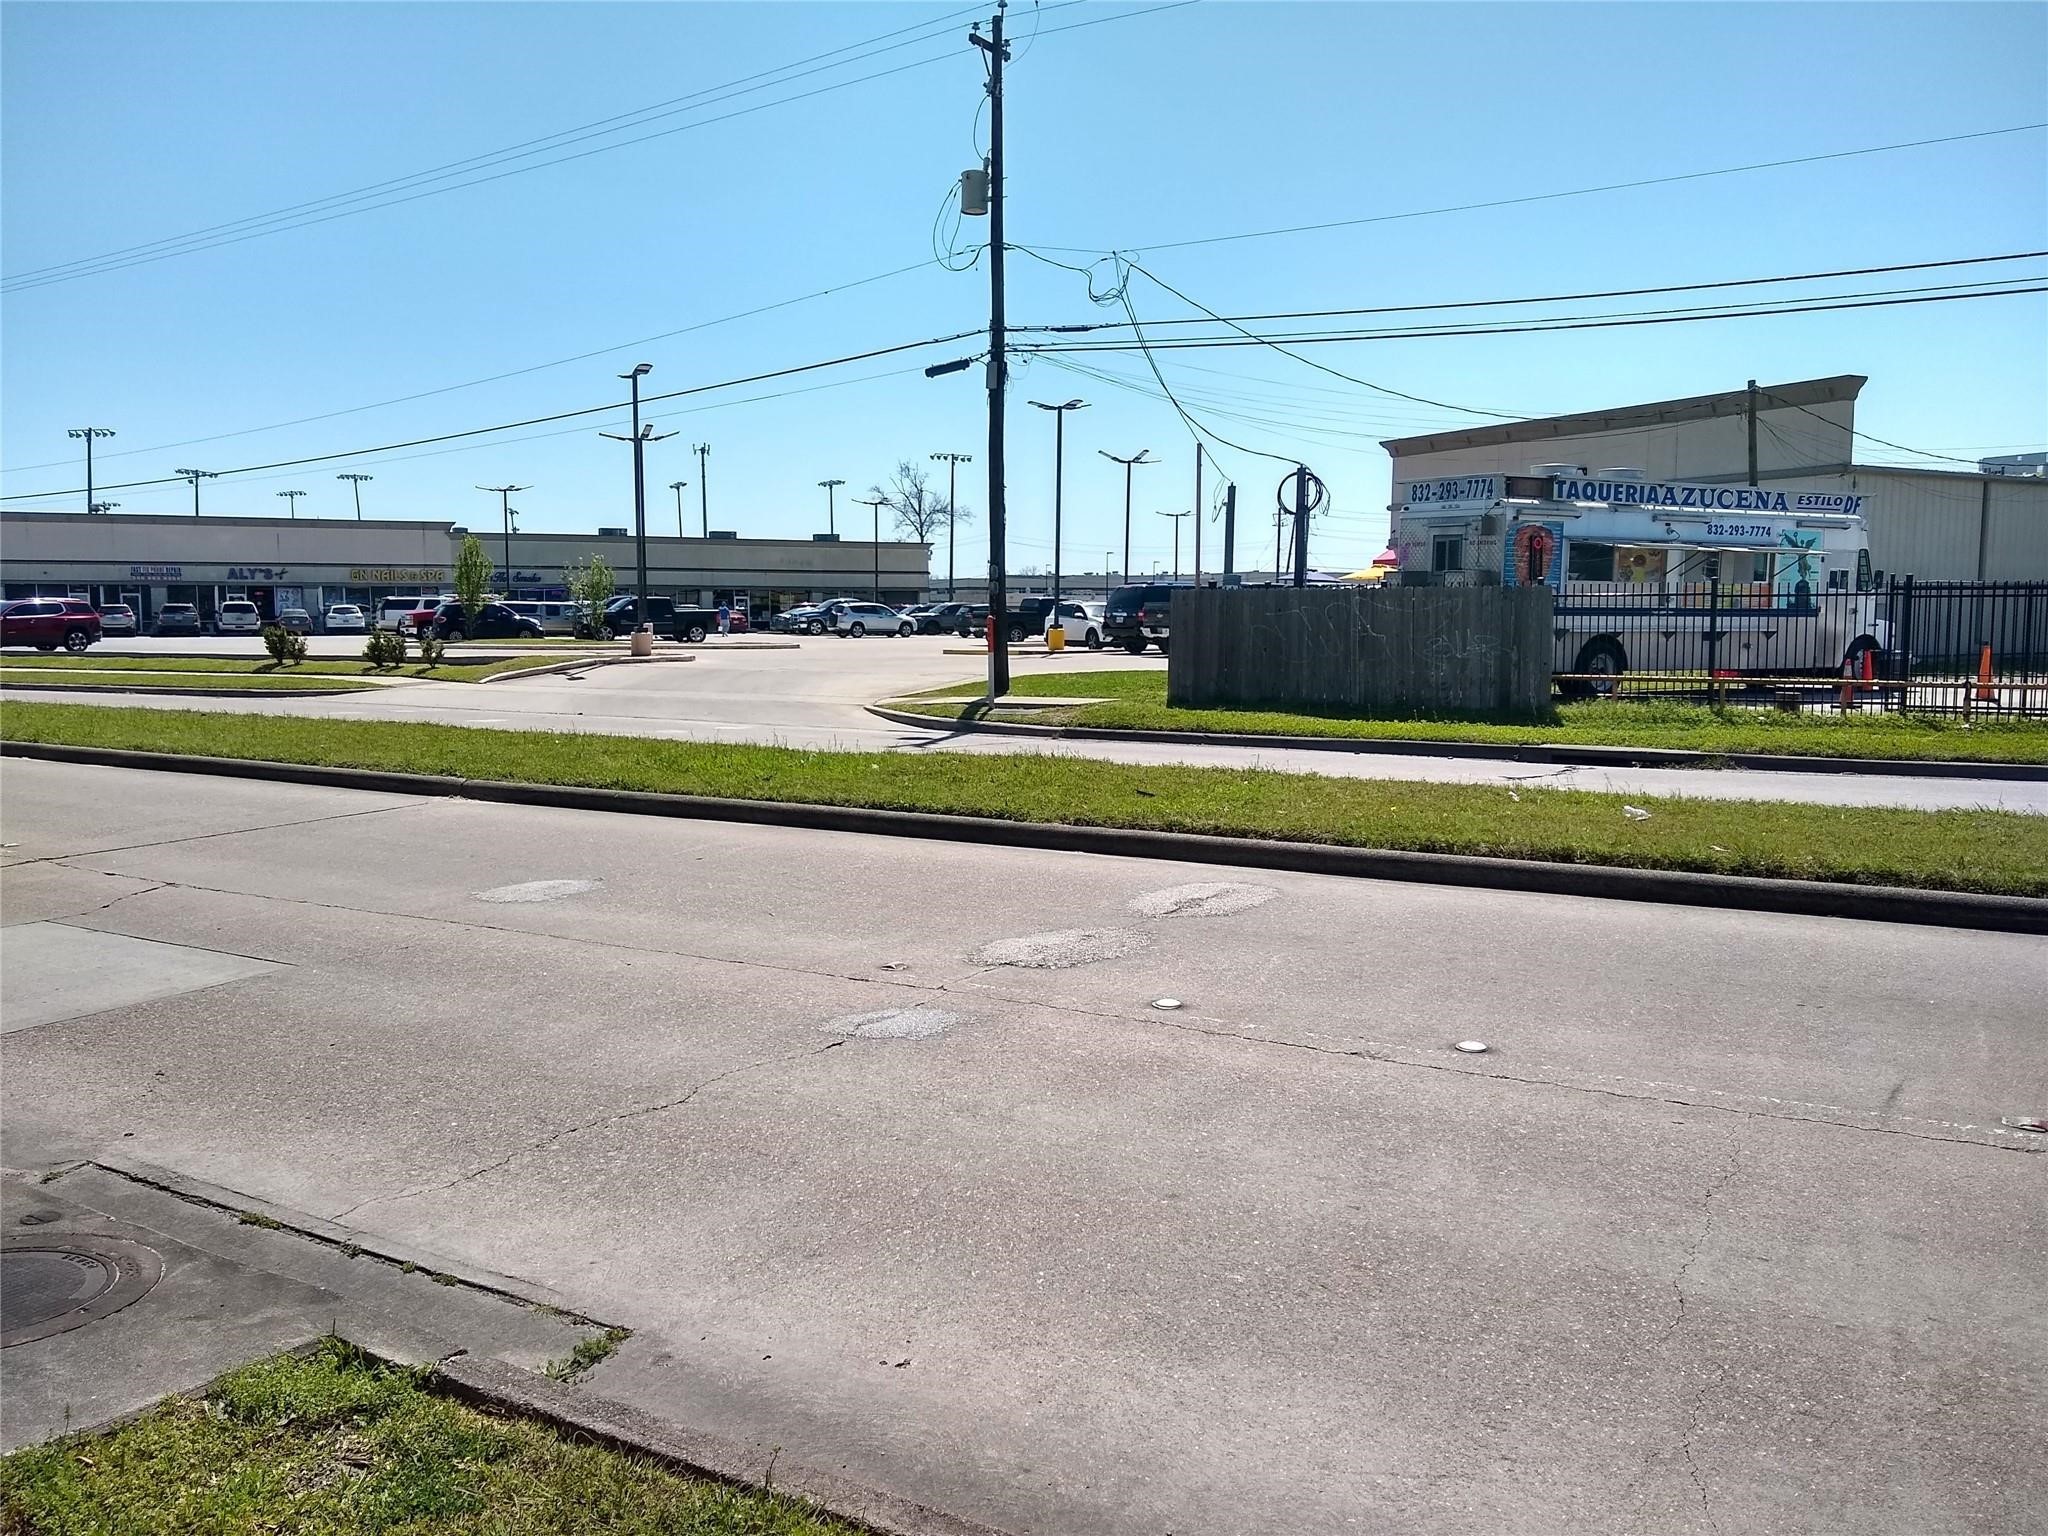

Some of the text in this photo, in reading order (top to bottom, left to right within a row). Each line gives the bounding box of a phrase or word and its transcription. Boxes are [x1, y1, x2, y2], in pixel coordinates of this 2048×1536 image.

[1412, 478, 1493, 501] 832-293-7774
[1556, 480, 1862, 514] TAQUERIA AZUCENA ESTILO DF
[1707, 524, 1771, 537] 832-293-7774
[372, 568, 408, 581] NAILS
[420, 568, 445, 581] SPA
